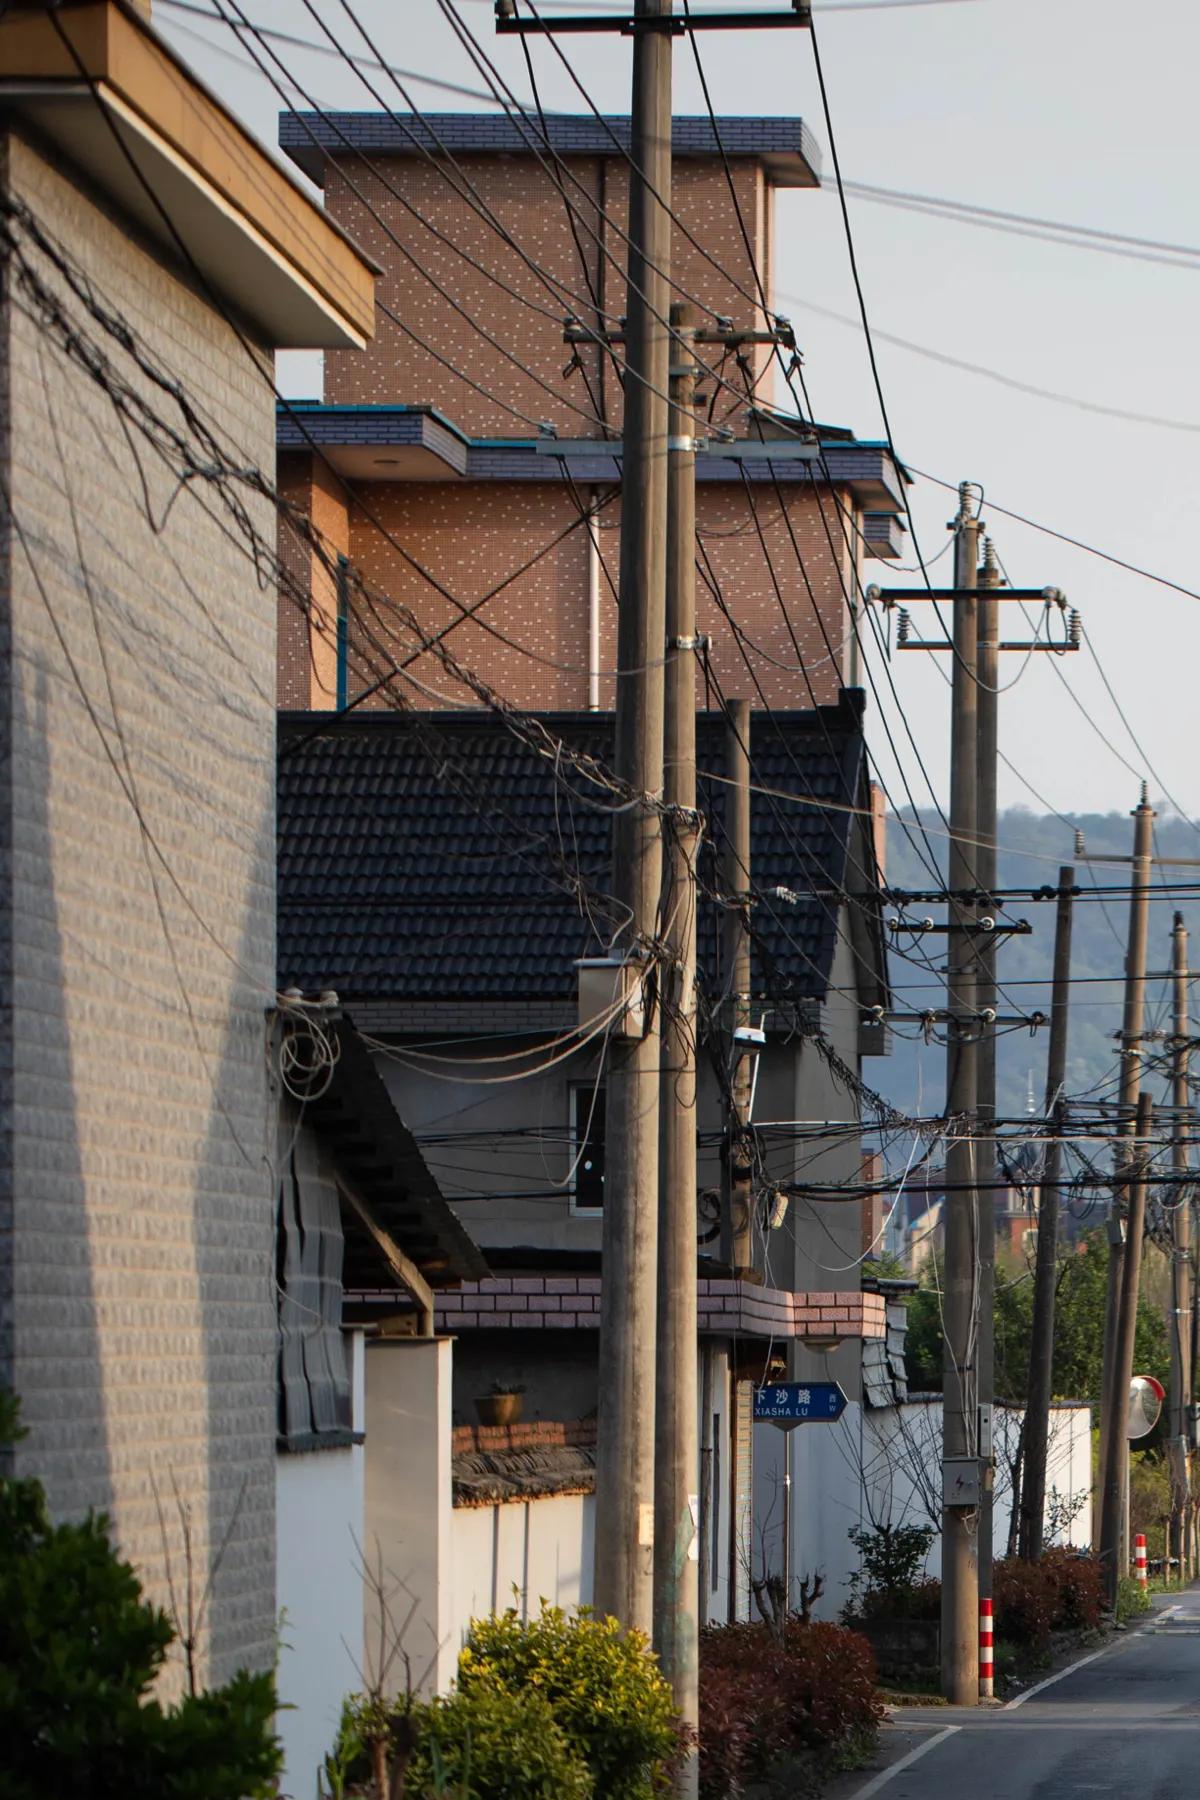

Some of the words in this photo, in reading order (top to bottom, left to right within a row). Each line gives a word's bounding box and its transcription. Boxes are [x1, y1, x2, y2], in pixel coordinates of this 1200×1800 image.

[755, 1389, 811, 1404] 下沙路
[755, 1407, 791, 1416] XIASHA
[796, 1407, 808, 1416] LU
